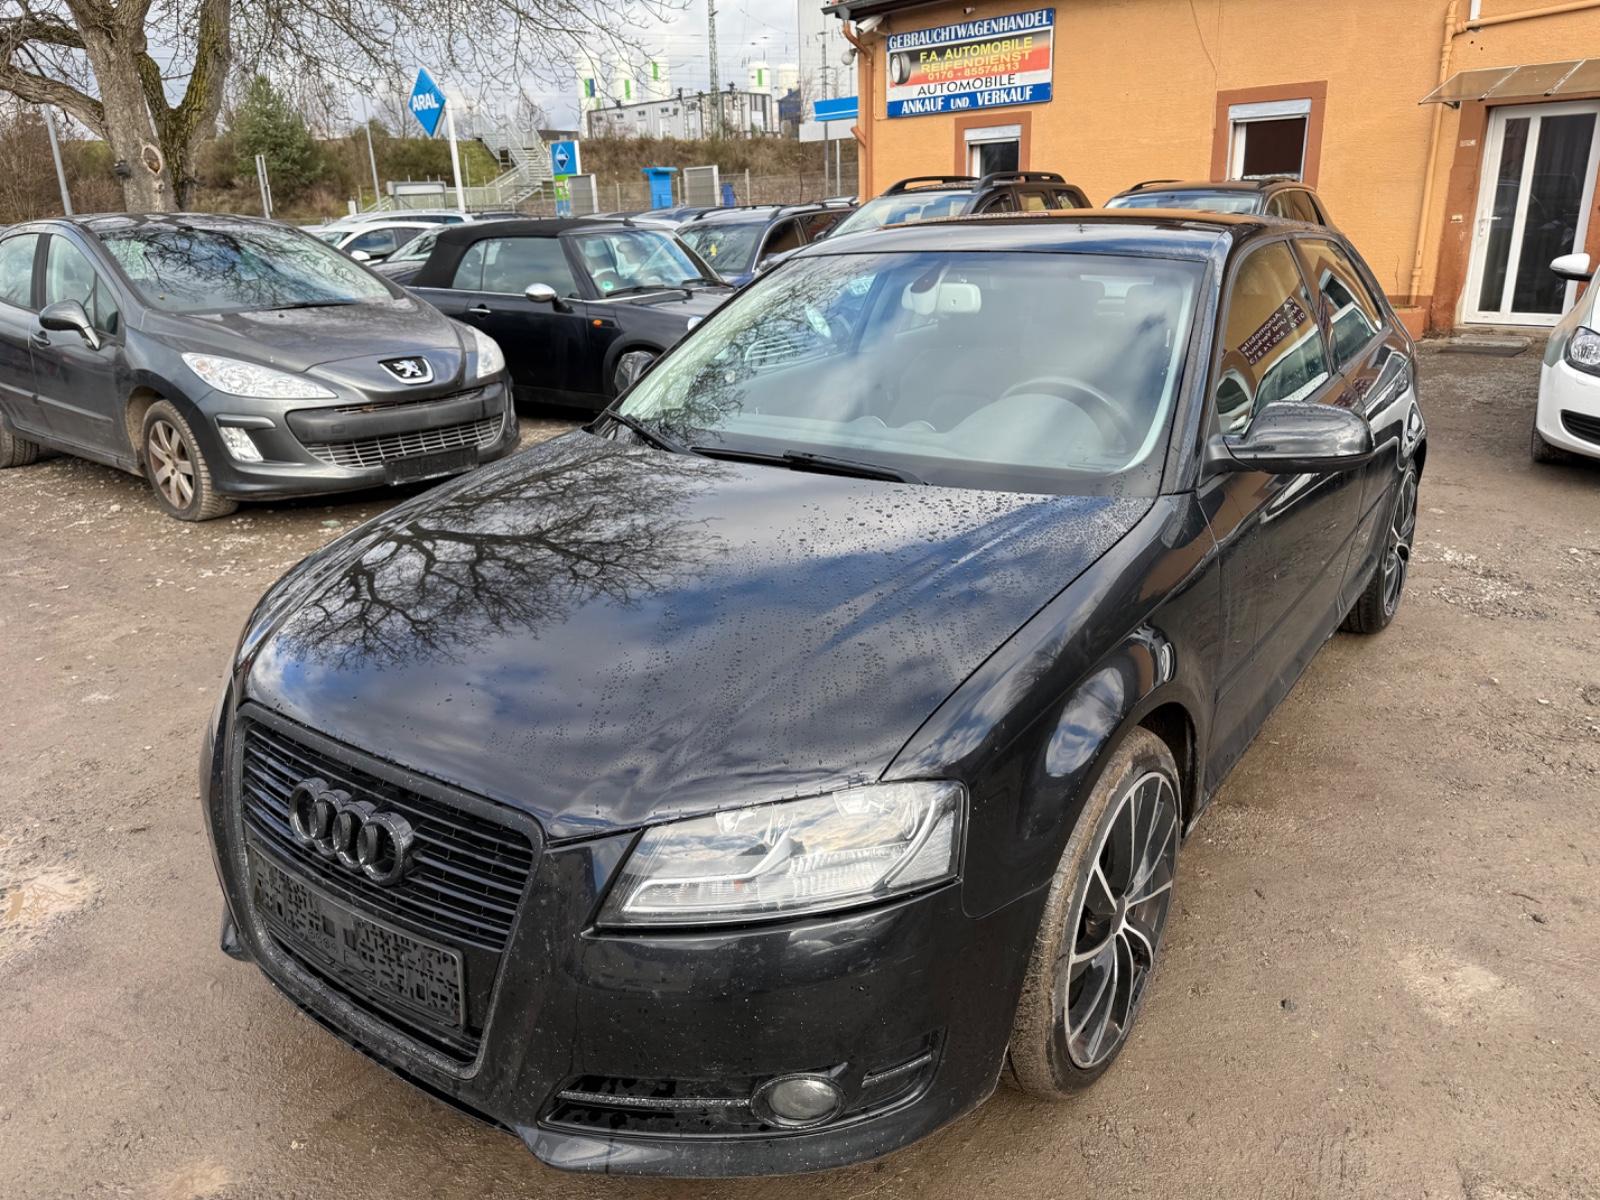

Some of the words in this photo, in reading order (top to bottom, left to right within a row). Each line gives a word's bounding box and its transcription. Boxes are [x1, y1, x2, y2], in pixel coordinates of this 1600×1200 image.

[889, 10, 1050, 48] GEBRAUCHTWAGENHANDEL
[920, 52, 941, 63] F.A.
[944, 37, 1033, 59] AUTOMOBILE
[920, 50, 1032, 73] REIFENDIENST
[918, 74, 1016, 96] AUTOMOBILE
[928, 71, 954, 80] 0176
[413, 93, 439, 111] ARAL
[902, 97, 945, 114] ANKAUF
[977, 86, 1034, 106] VERKAUF
